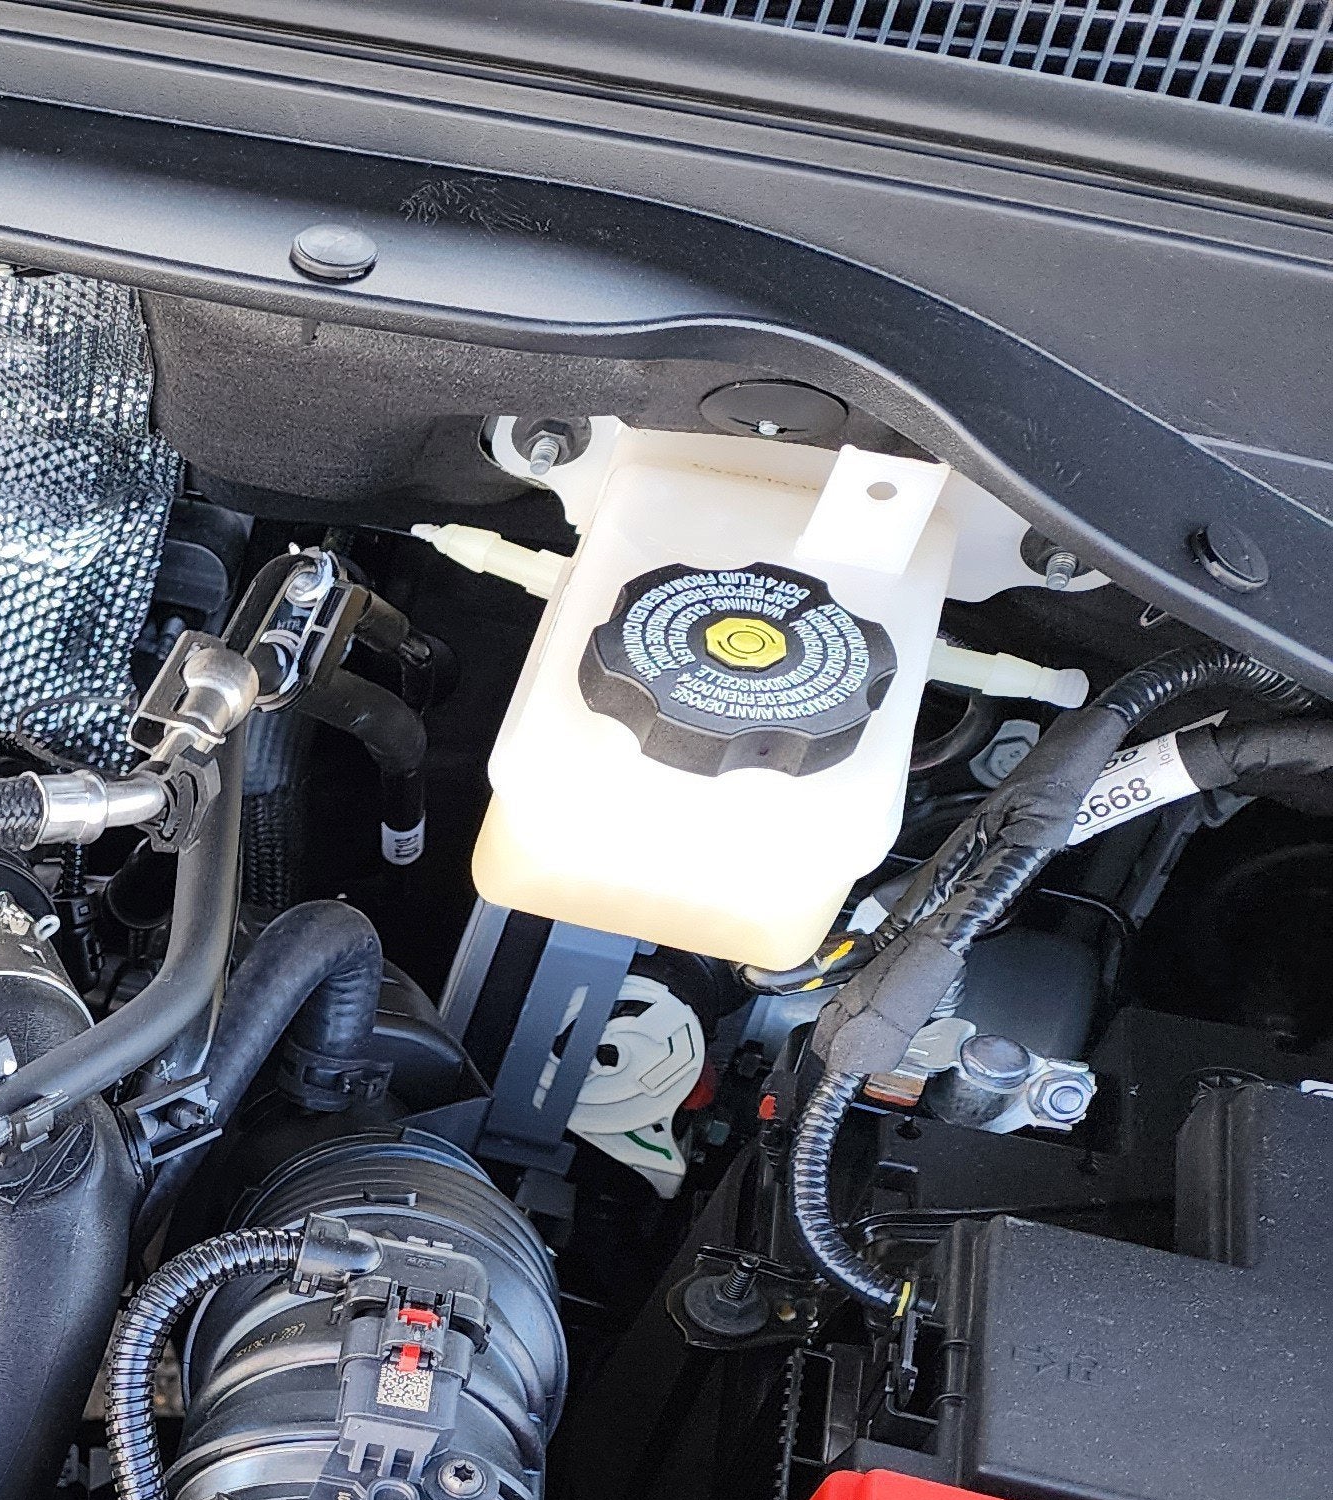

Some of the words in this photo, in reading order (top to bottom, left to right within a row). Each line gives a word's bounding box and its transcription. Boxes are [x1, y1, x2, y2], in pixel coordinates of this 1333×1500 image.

[670, 572, 717, 592] FROM
[717, 571, 765, 587] FLUID
[702, 585, 765, 599] BEFORE
[773, 580, 811, 600] DOT
[764, 592, 799, 609] CAP
[670, 603, 711, 631] CLEAN
[668, 629, 696, 666] FILLER
[726, 704, 774, 720] AVANT
